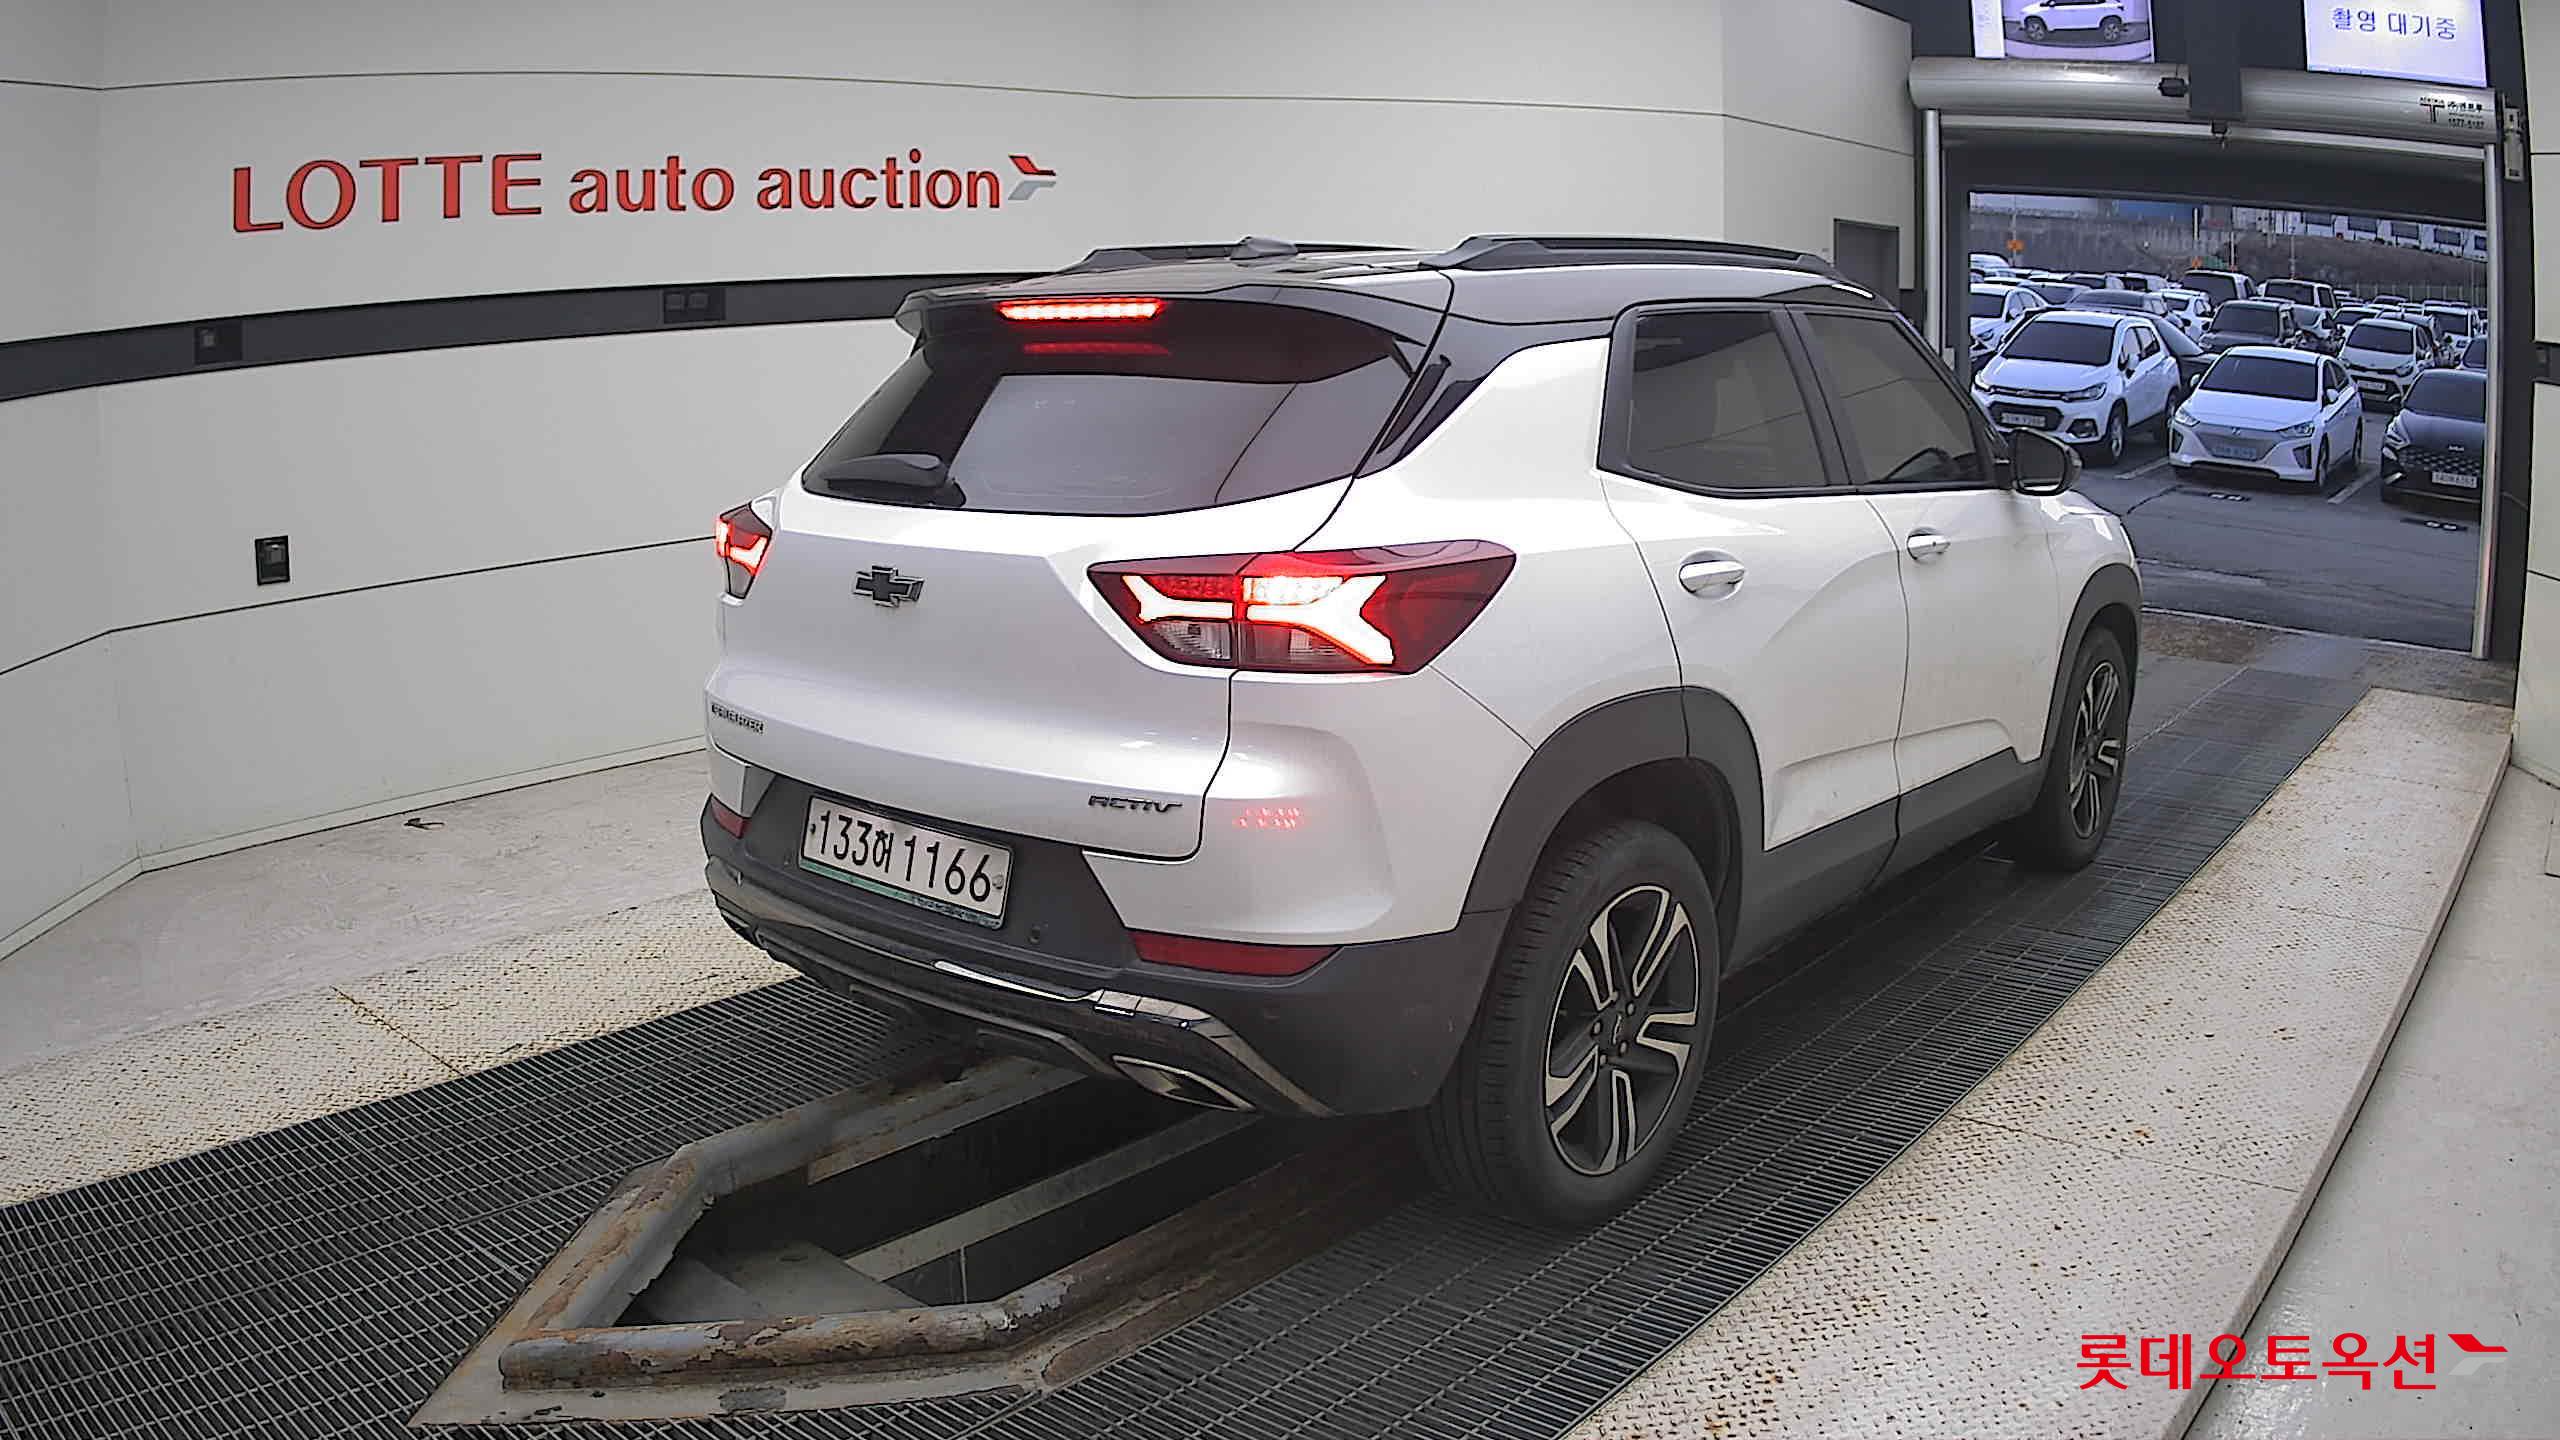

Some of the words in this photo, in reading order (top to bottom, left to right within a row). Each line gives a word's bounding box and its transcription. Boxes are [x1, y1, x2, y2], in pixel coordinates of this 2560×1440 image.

[2332, 7, 2376, 32] 촬영
[2387, 13, 2457, 40] 대기중
[232, 152, 543, 234] LOTTE
[568, 155, 735, 214] auto
[756, 147, 1001, 210] auction
[1087, 794, 1184, 813] ACTIV
